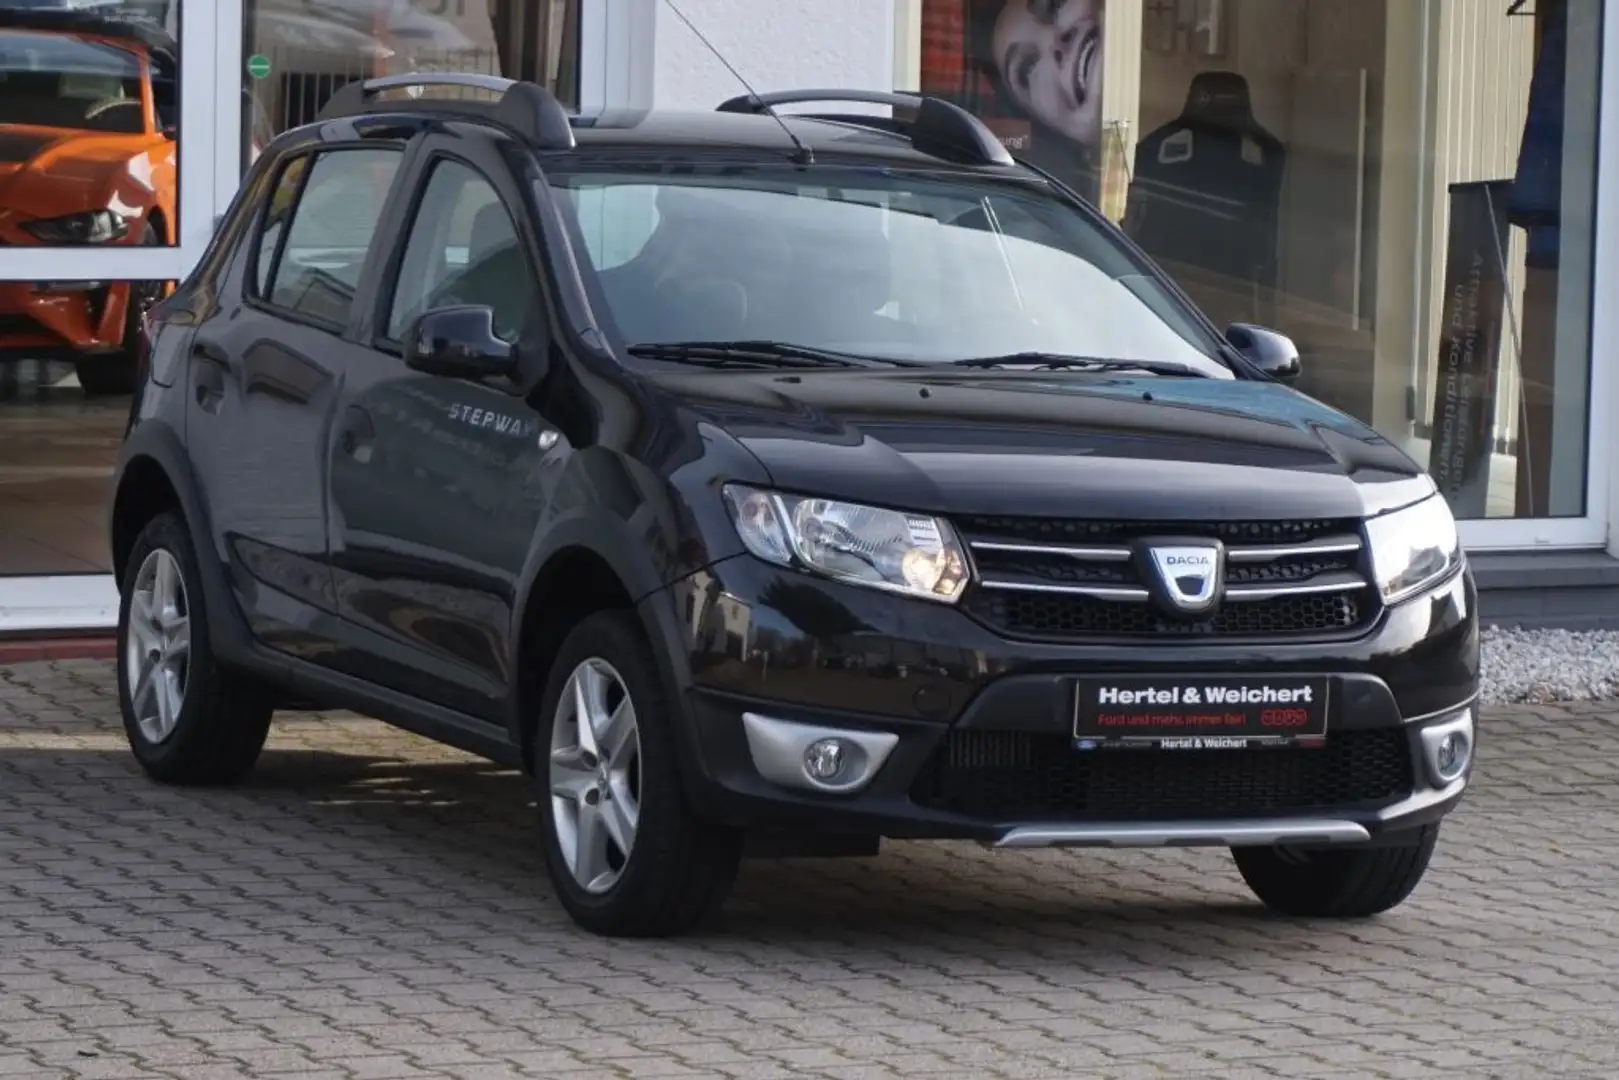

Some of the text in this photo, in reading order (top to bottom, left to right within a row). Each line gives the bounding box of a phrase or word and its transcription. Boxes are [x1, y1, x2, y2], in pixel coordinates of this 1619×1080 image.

[1451, 284, 1465, 329] und
[1166, 555, 1209, 565] DACIA
[1099, 685, 1314, 704] Hertel & Weichert
[1097, 712, 1126, 725] Ford
[1127, 712, 1150, 725] und
[1160, 737, 1193, 749] Hertel
[1194, 737, 1203, 749] &
[1204, 736, 1248, 748] Weichert
